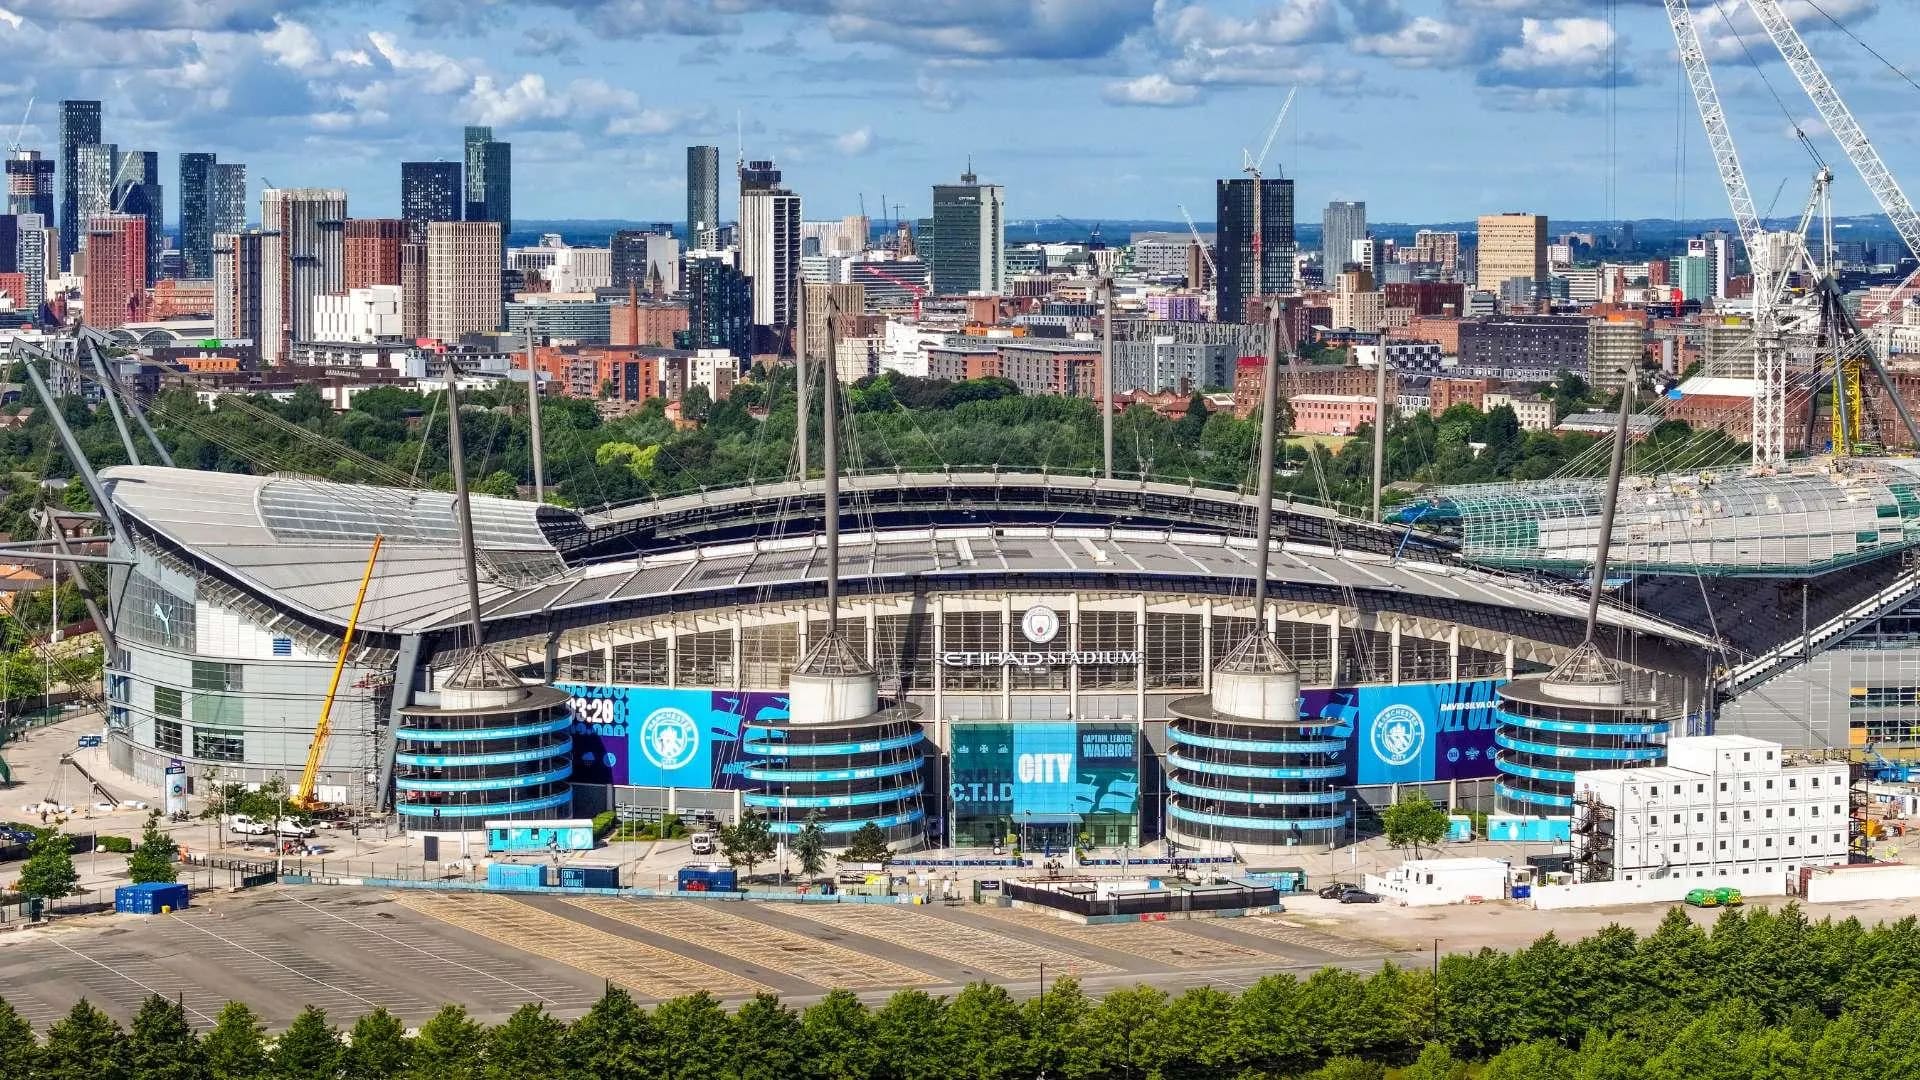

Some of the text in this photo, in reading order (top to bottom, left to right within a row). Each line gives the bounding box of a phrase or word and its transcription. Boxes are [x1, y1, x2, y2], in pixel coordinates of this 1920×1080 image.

[943, 651, 1138, 666] ETIHAD STADIUM
[1440, 702, 1465, 711] DAVID
[1465, 701, 1486, 710] SILVA
[1377, 708, 1420, 730] MANCHESTER
[1082, 743, 1132, 757] WARRIOR
[1017, 753, 1073, 784] CITY
[563, 871, 575, 879] CITY
